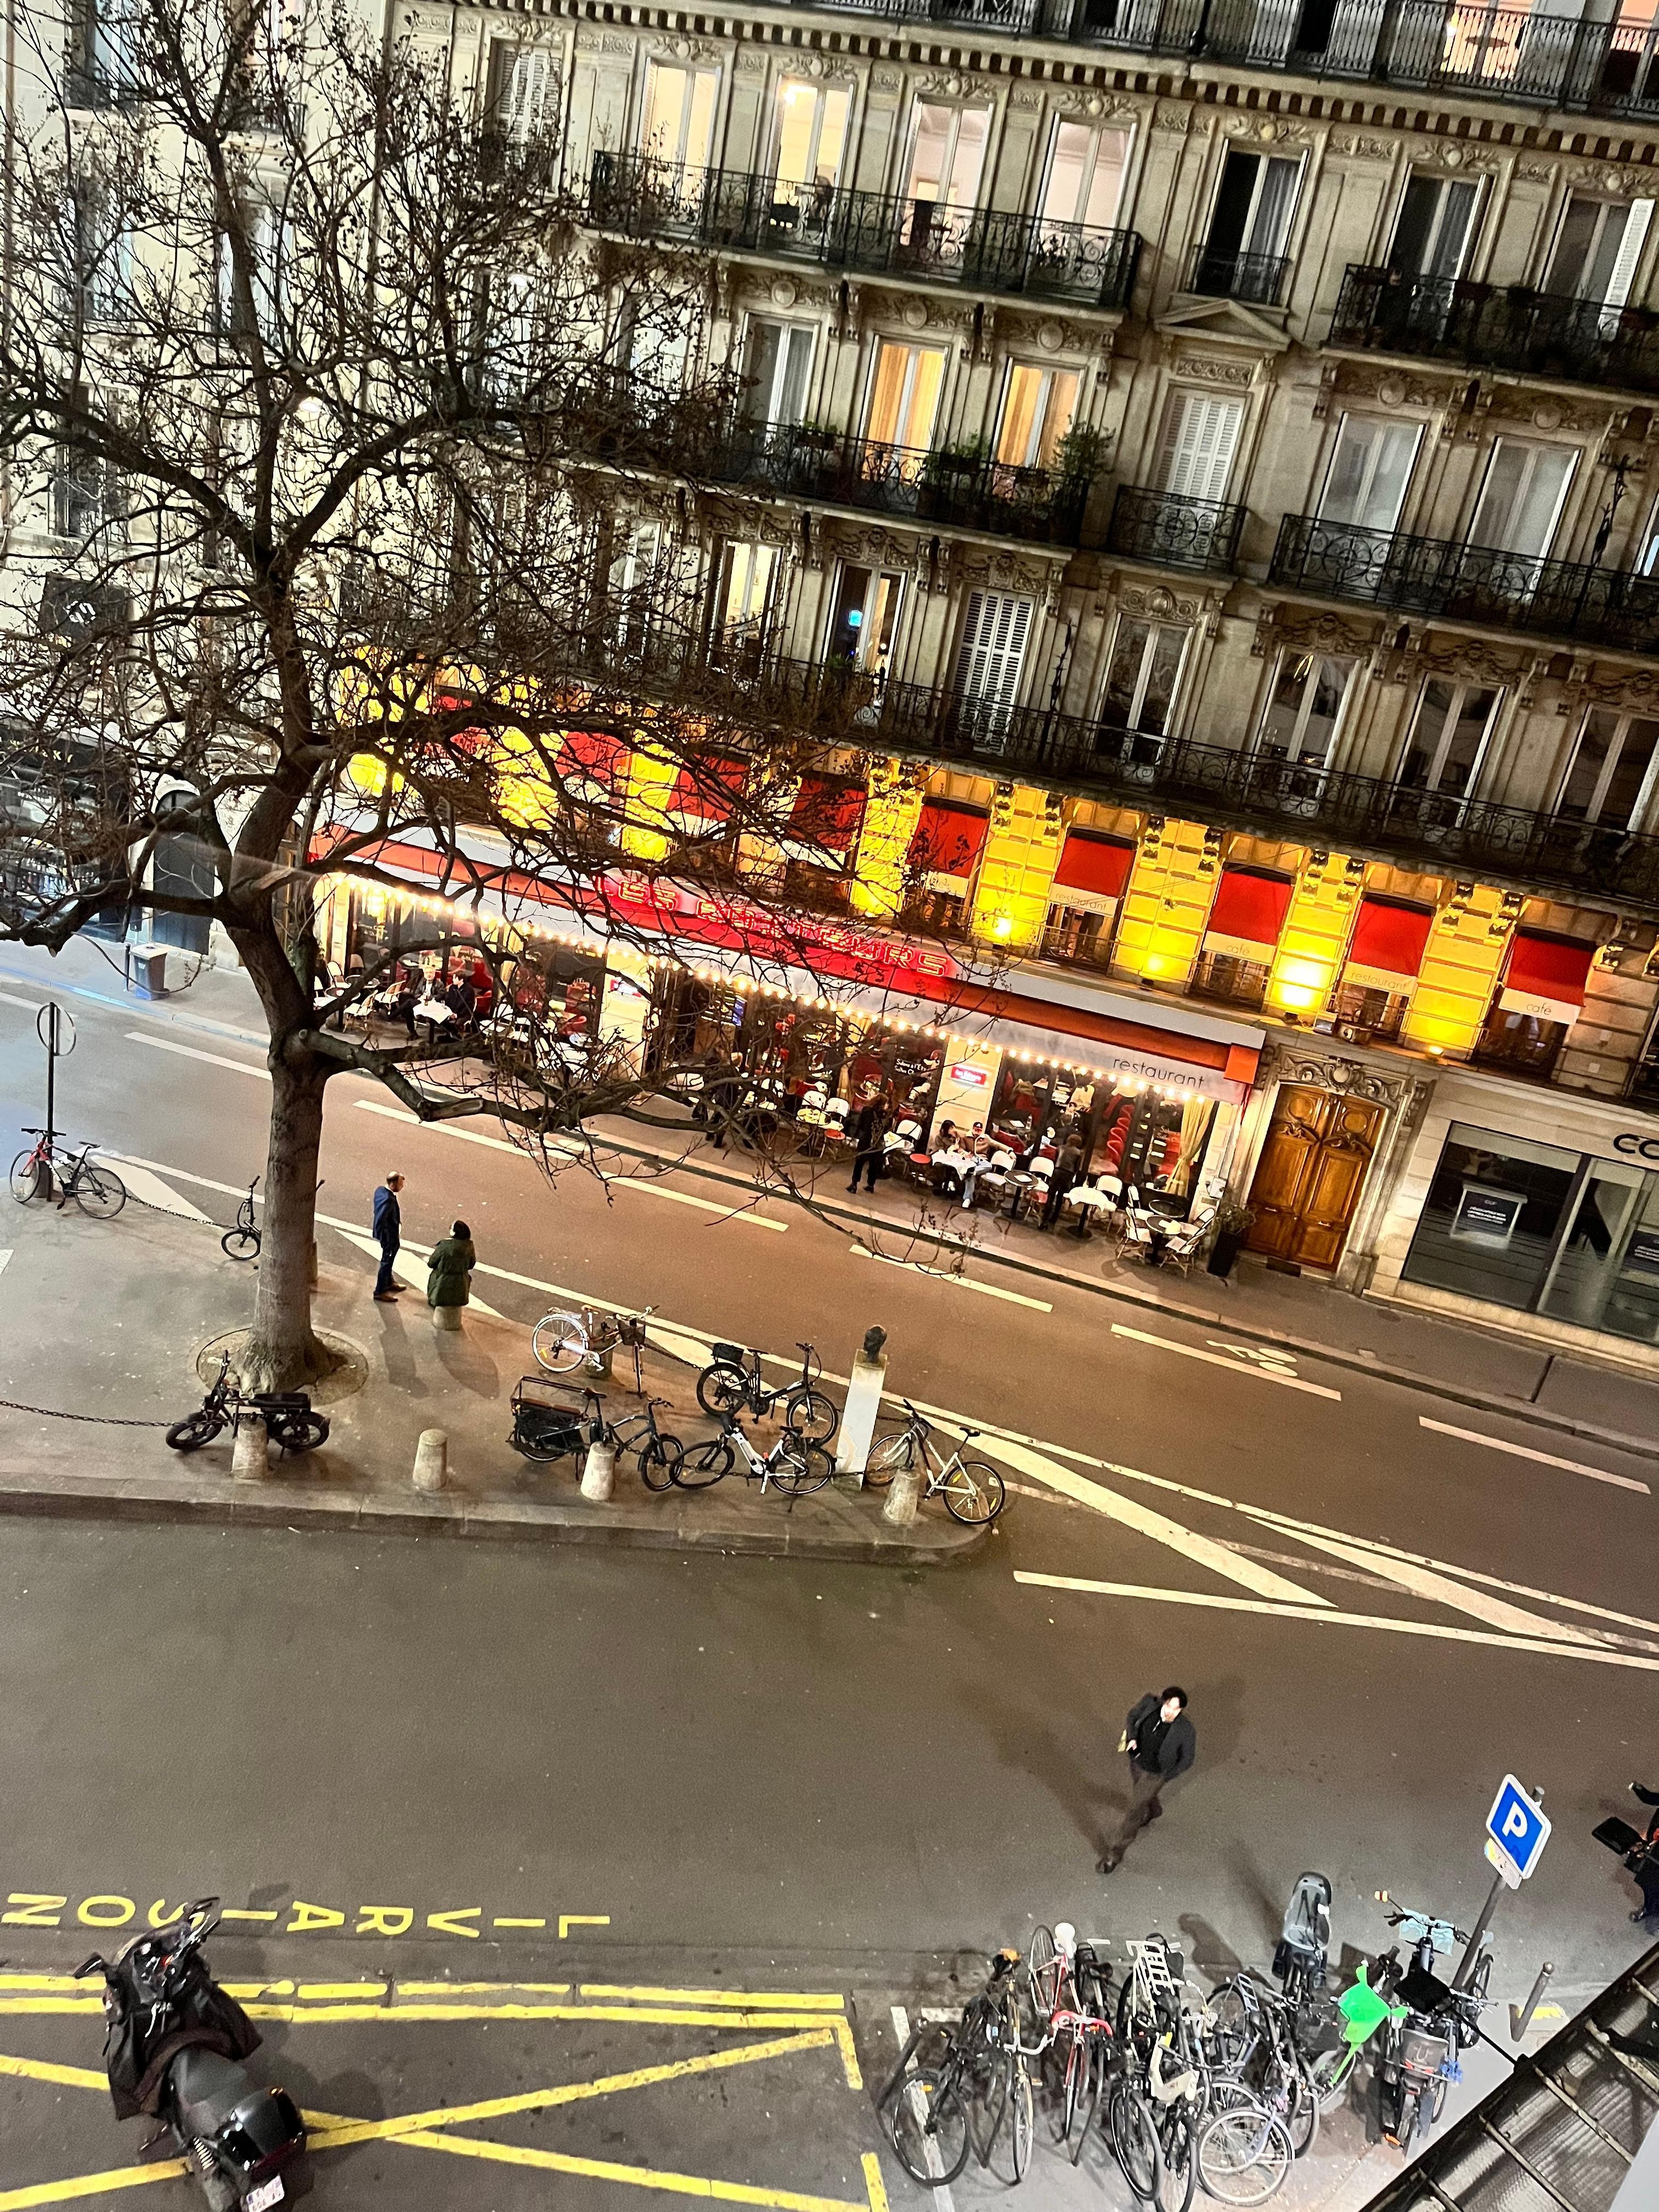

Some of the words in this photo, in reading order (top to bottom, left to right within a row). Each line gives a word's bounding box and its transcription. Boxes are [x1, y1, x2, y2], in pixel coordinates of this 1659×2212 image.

[1056, 891, 1108, 911] restaurant
[1226, 943, 1250, 956] café
[1351, 971, 1407, 990] restaurant
[1526, 1002, 1553, 1015] café
[1113, 1058, 1204, 1088] restaurant
[1502, 1801, 1528, 1838] P
[1, 1892, 611, 1939] LIVRAISON
